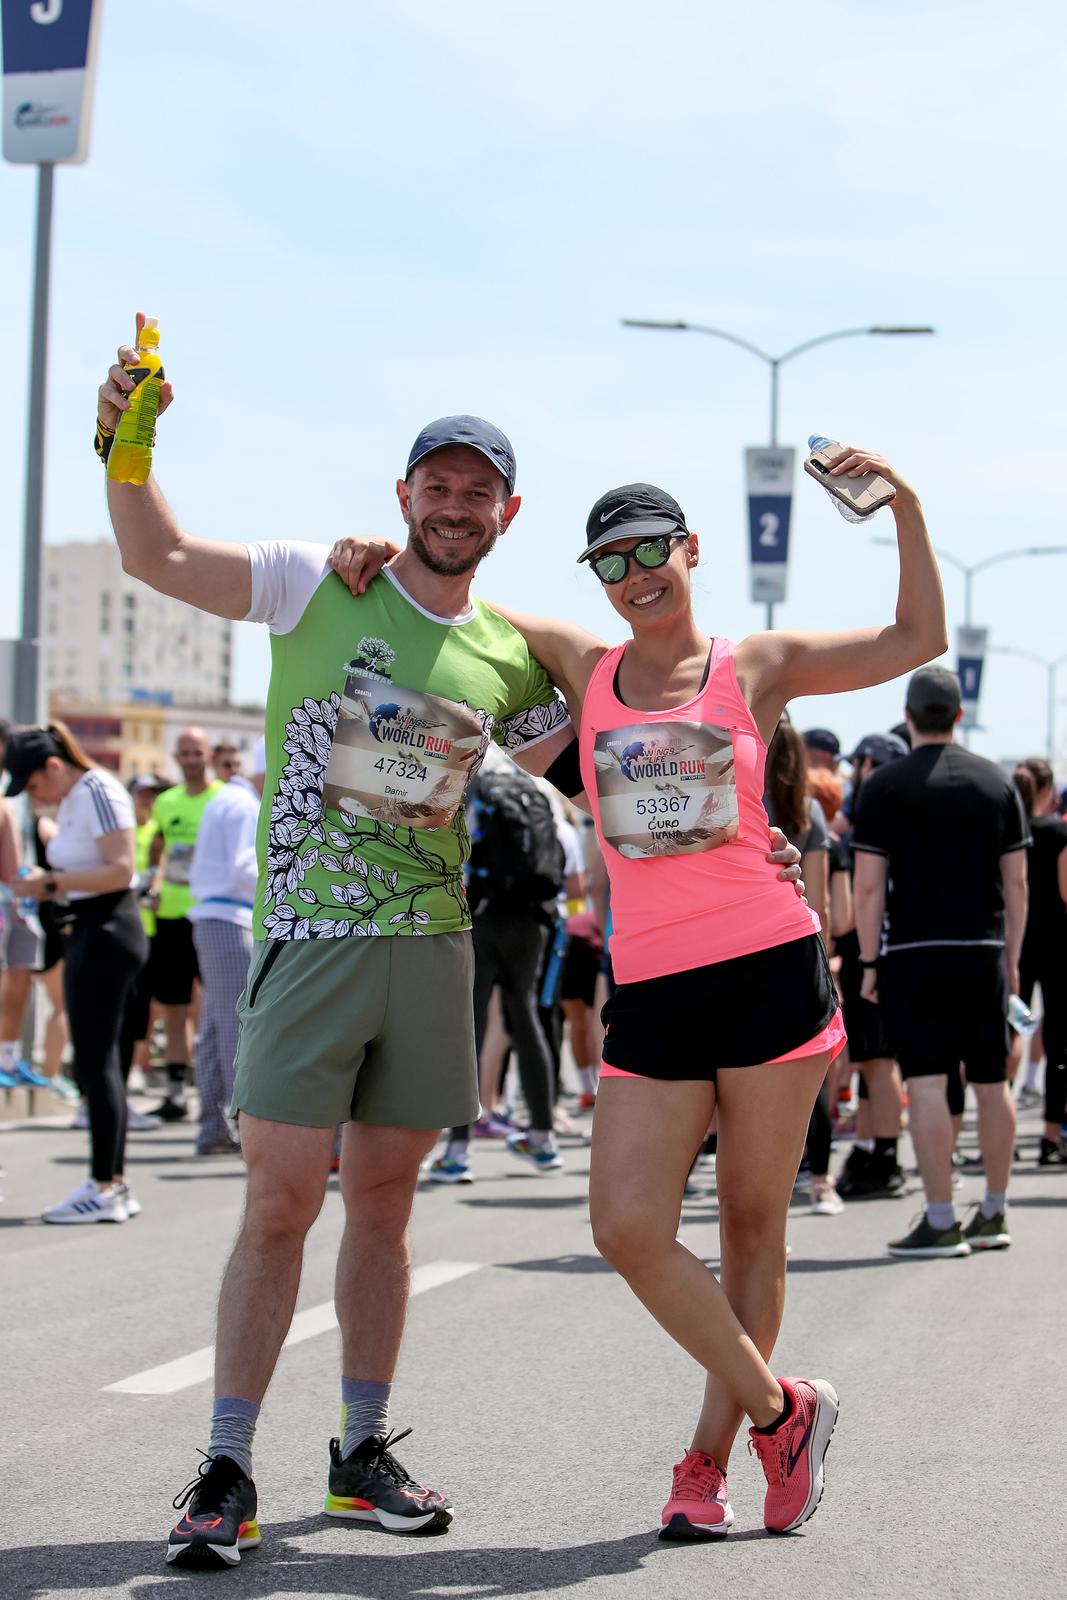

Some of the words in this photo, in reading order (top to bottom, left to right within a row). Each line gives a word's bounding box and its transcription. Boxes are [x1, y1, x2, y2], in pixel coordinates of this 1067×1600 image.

[759, 512, 779, 546] 2
[397, 713, 428, 728] WINGS
[382, 725, 426, 748] WORLD
[426, 735, 452, 755] RUN
[644, 746, 675, 757] WINGS
[649, 755, 666, 764] LIFE
[374, 757, 428, 782] 47324
[634, 762, 678, 779] WORLD
[680, 759, 705, 775] RUN
[384, 785, 408, 797] Damir
[636, 796, 690, 815] 53367
[648, 816, 679, 830] ĆURO
[651, 830, 683, 840] IVANA
